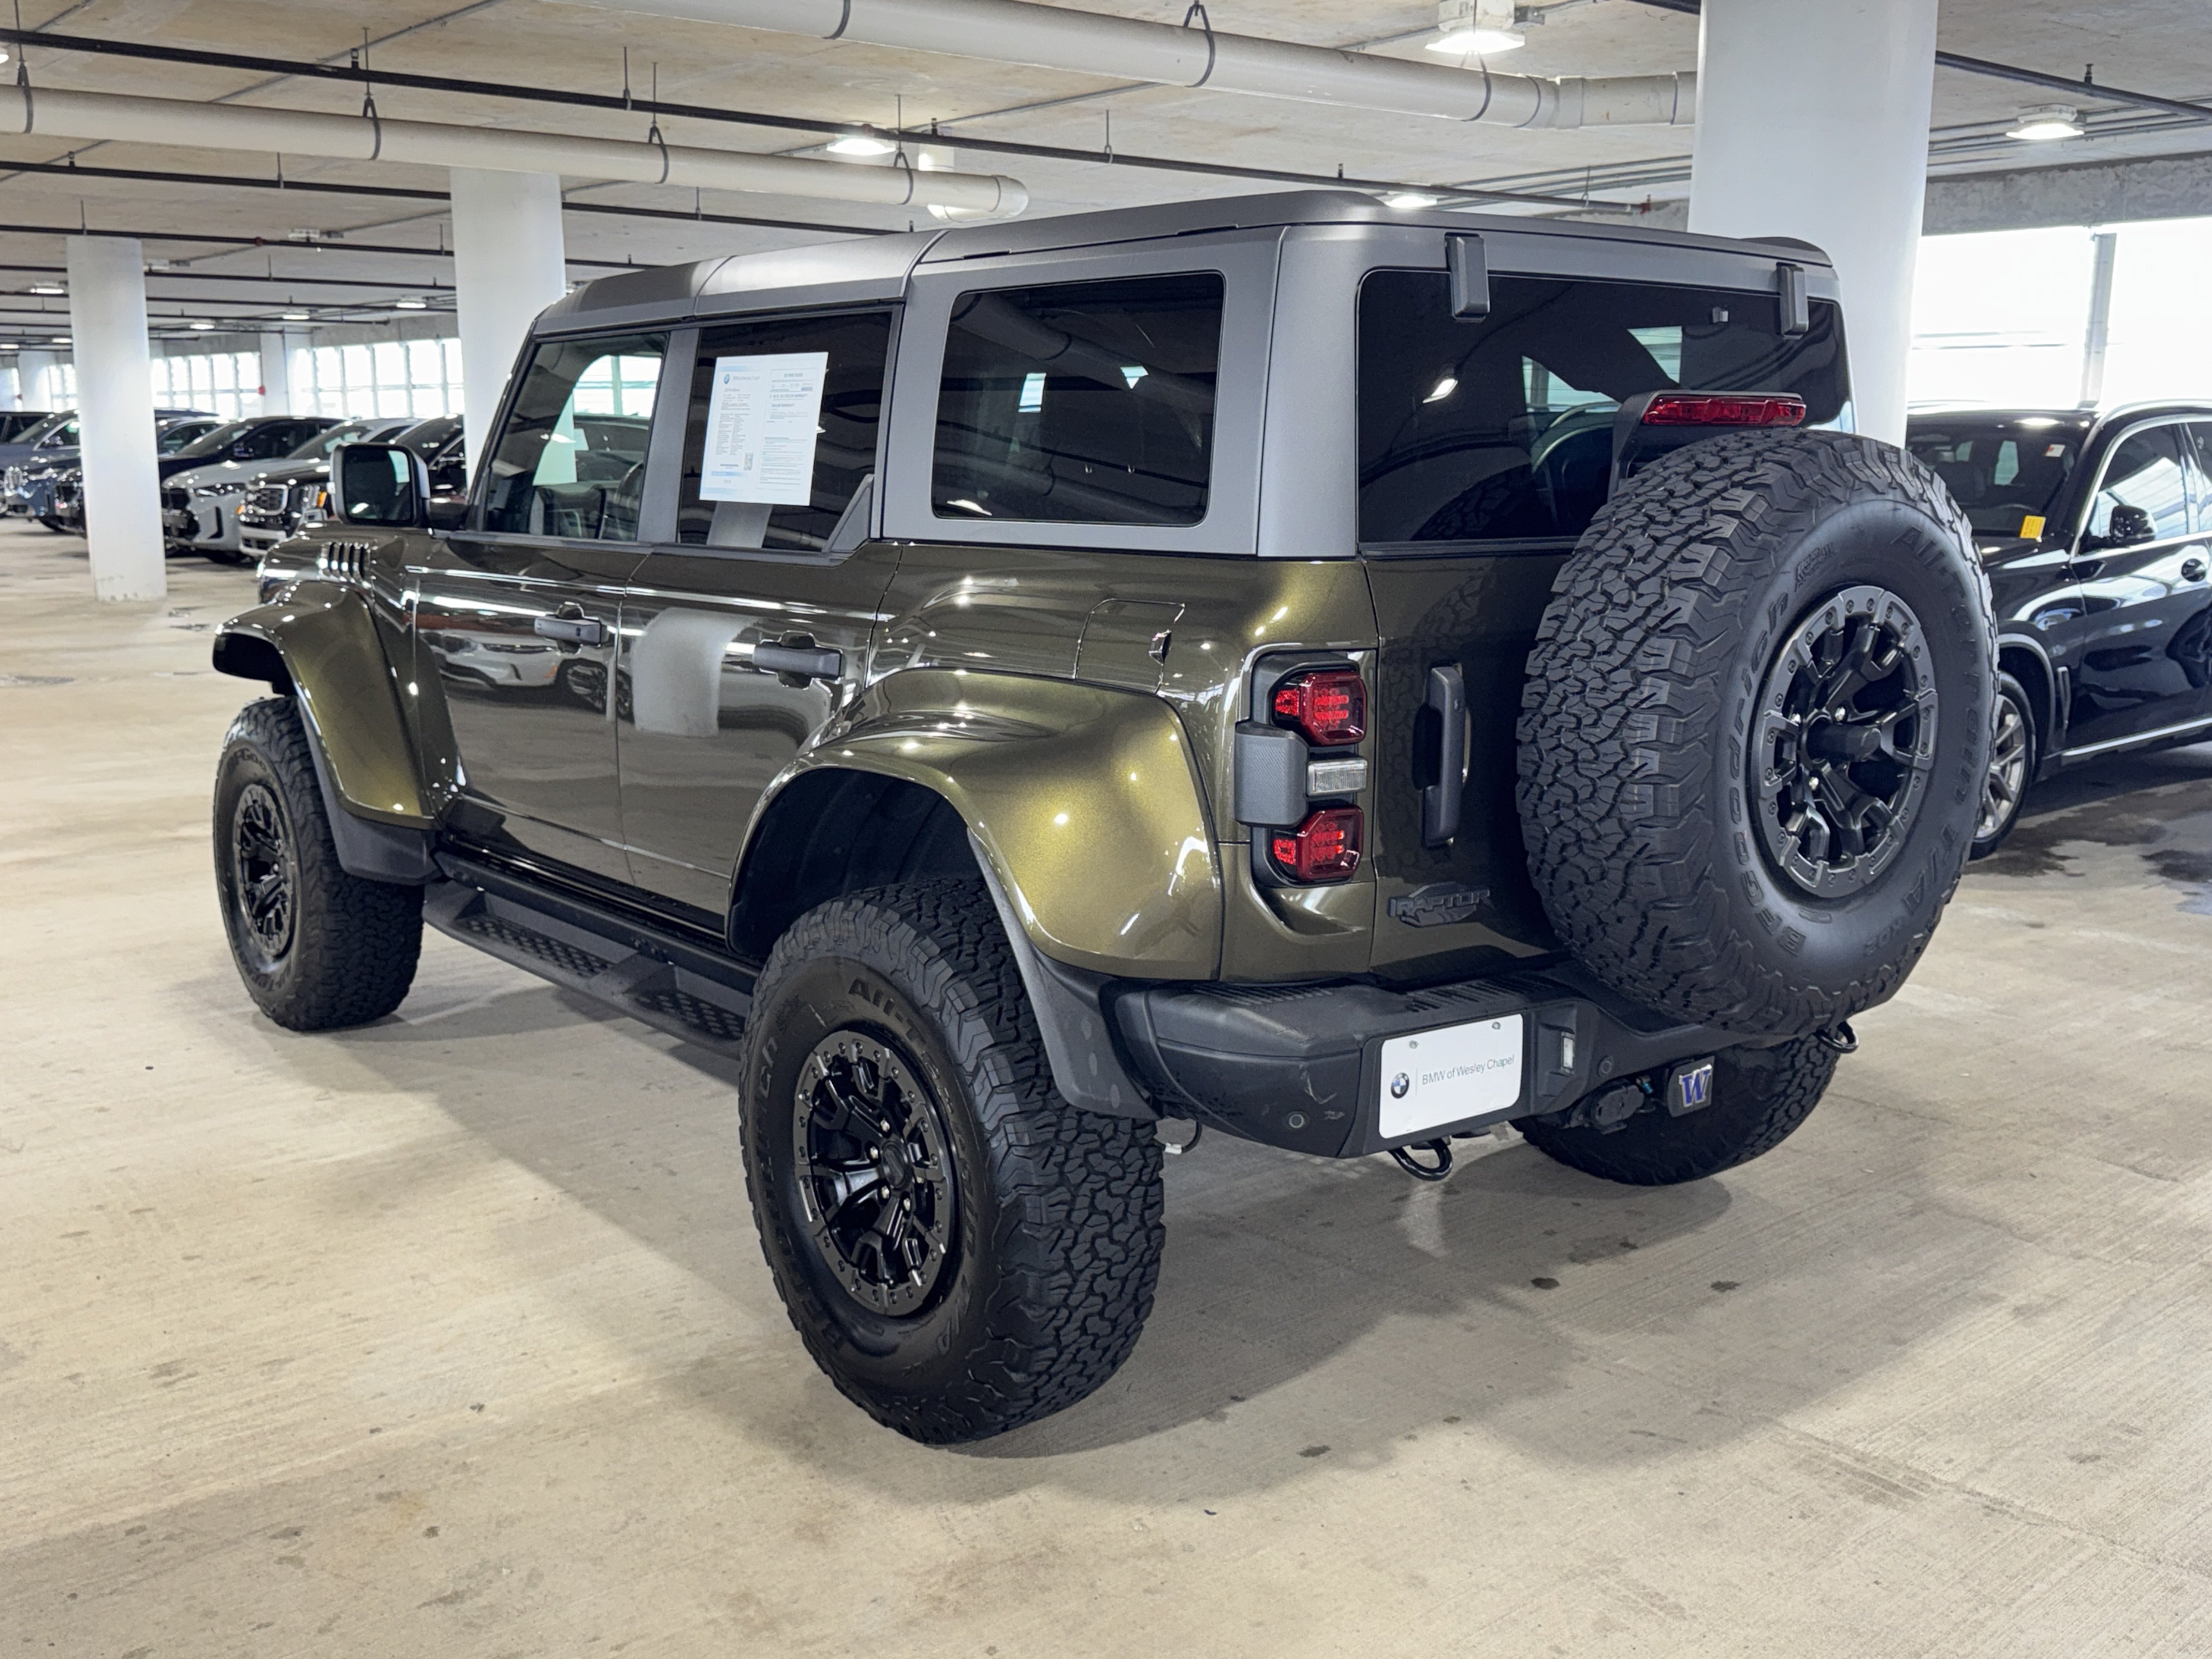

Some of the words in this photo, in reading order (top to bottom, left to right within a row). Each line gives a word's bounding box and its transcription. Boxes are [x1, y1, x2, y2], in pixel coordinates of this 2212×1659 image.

[1729, 592, 1807, 957] BFGoodrich
[1396, 889, 1493, 917] RAPTOR
[1422, 1070, 1446, 1085] BMW
[1447, 1067, 1455, 1080] of
[1457, 1062, 1486, 1077] Wesley
[1487, 1054, 1515, 1070] Chapel
[1678, 1064, 1713, 1108] W
